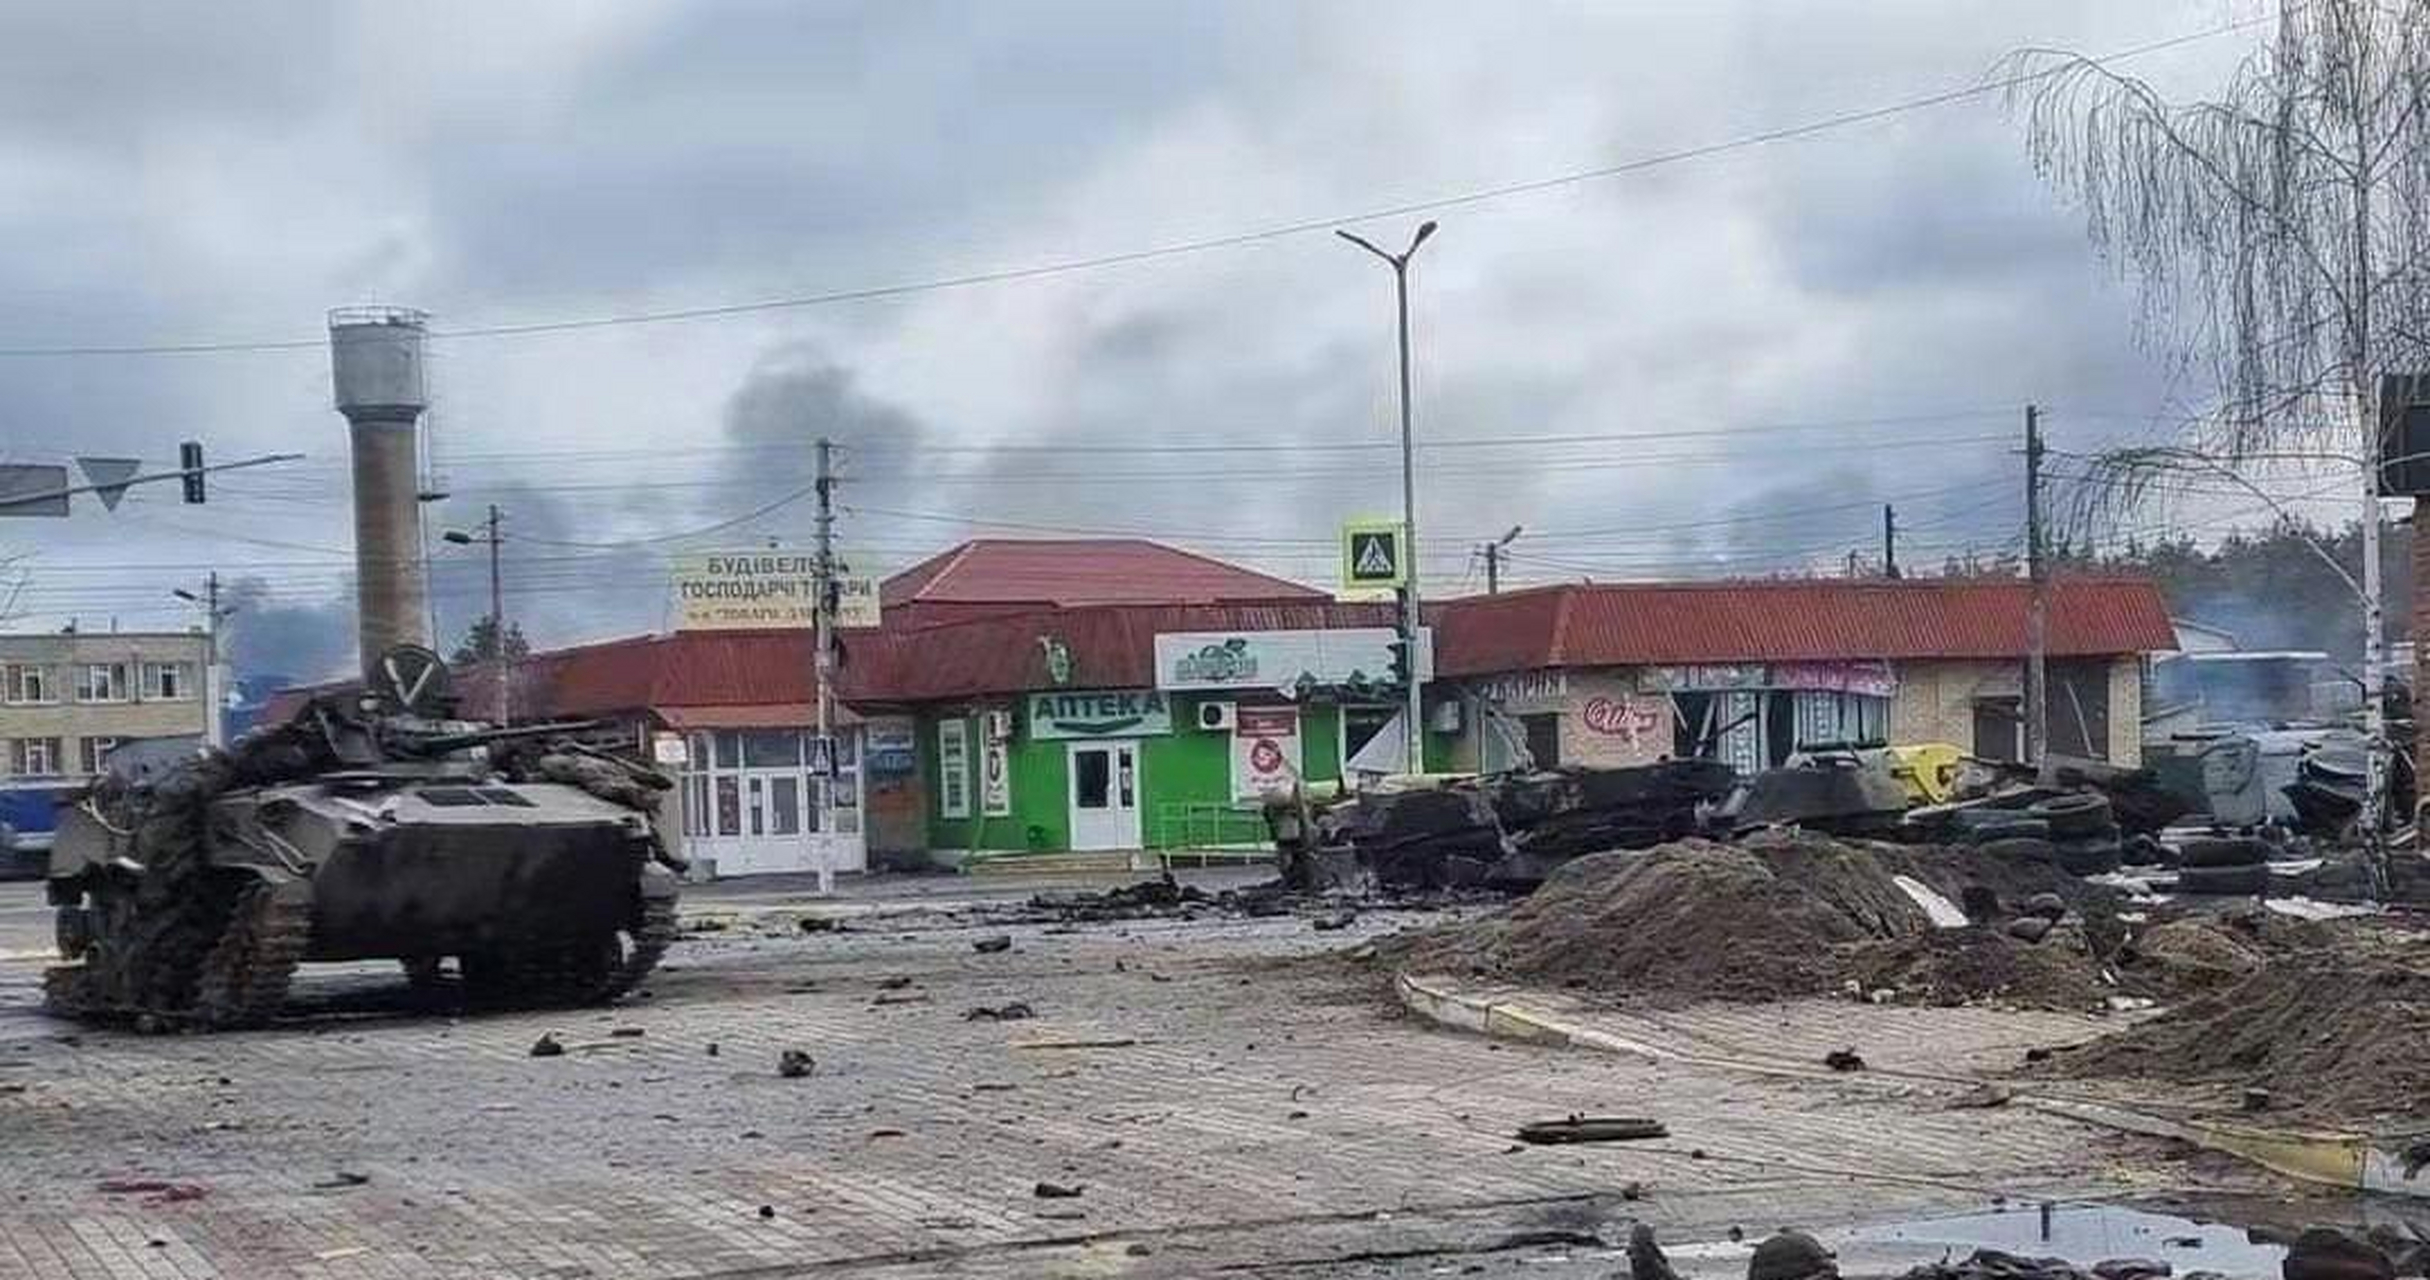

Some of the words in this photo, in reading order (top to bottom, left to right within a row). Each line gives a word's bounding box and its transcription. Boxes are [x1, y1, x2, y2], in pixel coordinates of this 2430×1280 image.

[682, 580, 796, 600] ГОСПОДАРЧІ
[384, 657, 434, 706] V
[1034, 693, 1165, 720] АПТЕКА
